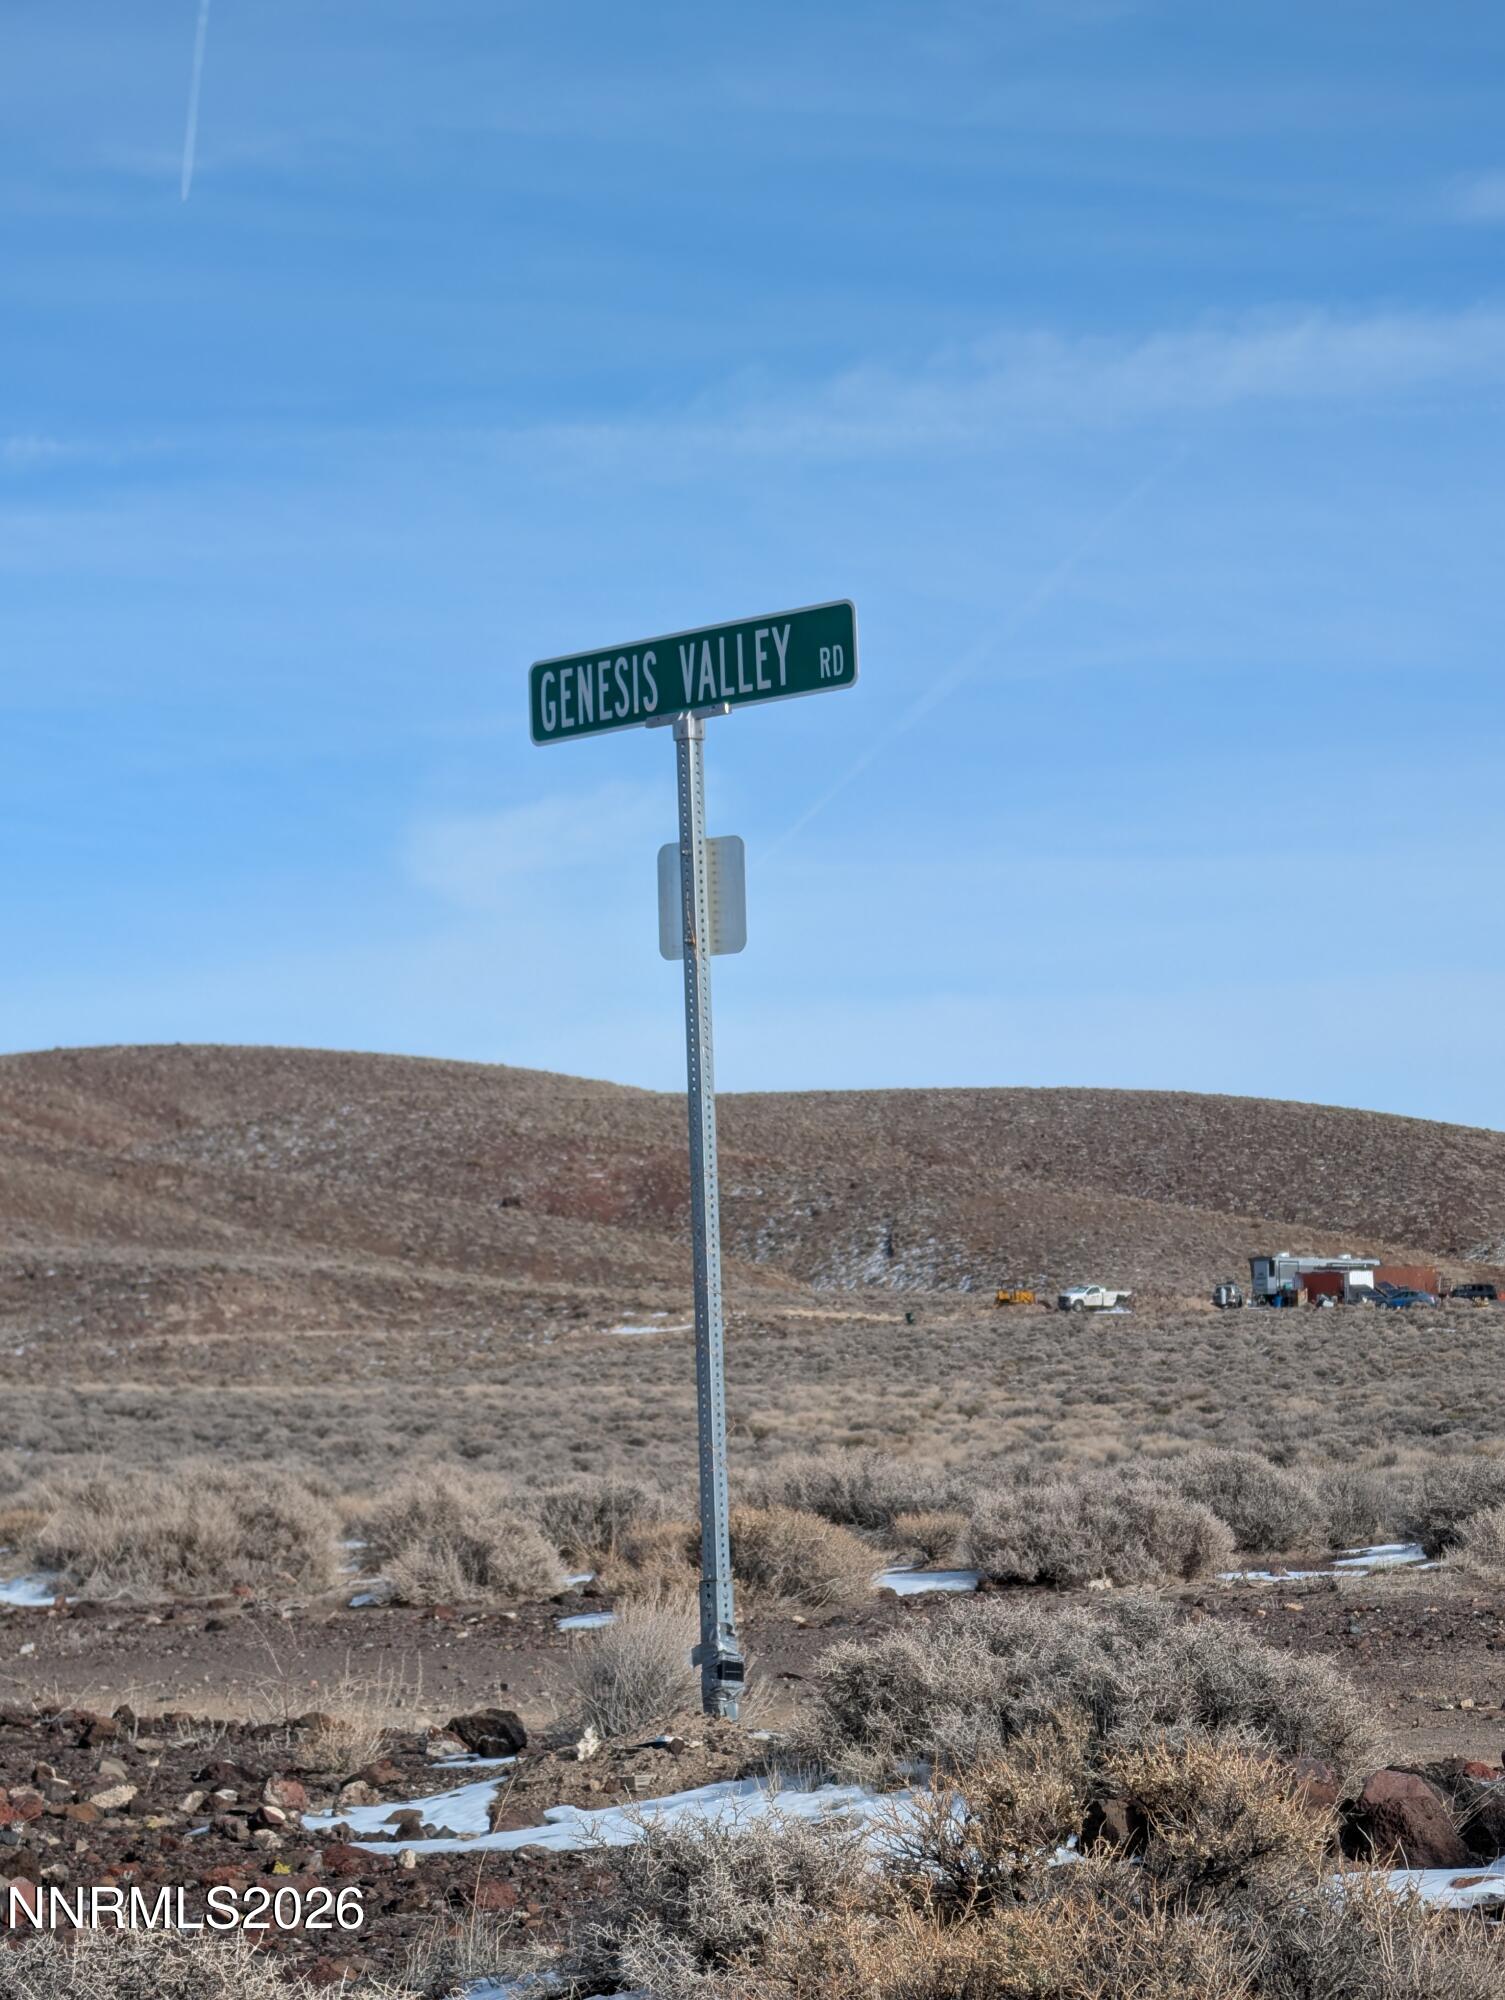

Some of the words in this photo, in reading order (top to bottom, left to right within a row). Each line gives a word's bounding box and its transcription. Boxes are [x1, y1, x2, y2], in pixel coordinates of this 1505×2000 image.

[540, 651, 659, 732] GENESIS
[679, 624, 791, 703] VALLEY
[819, 644, 844, 679] RD
